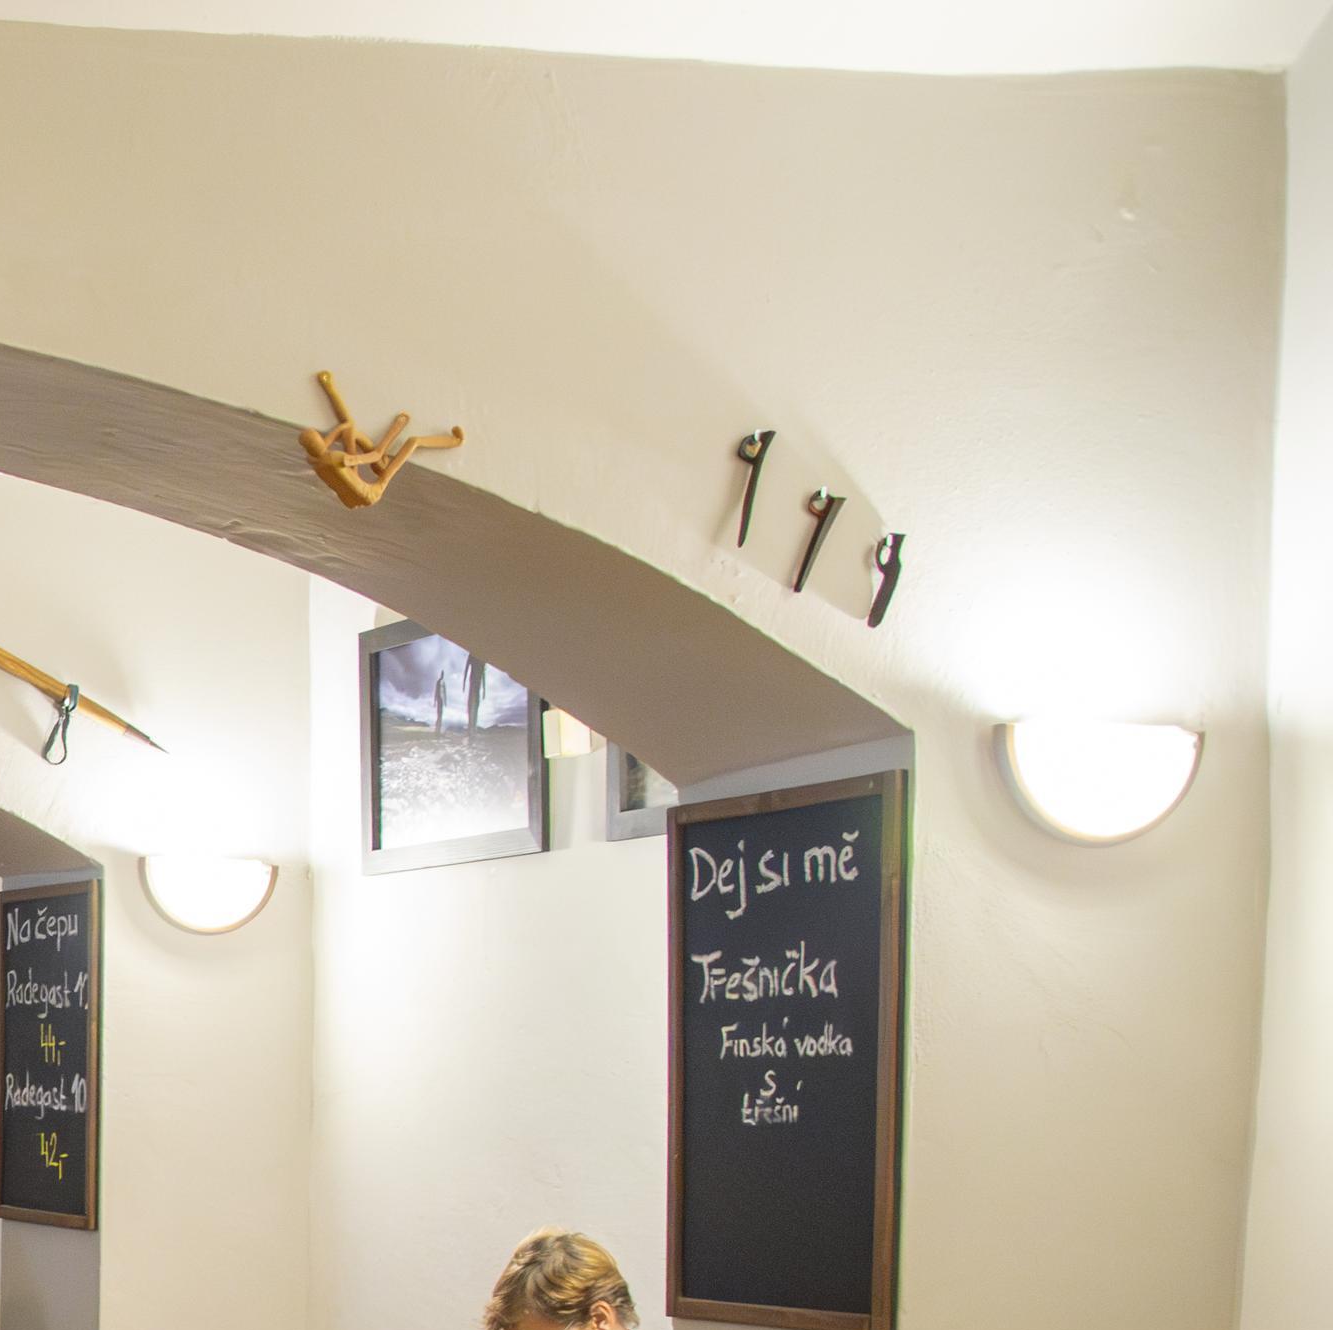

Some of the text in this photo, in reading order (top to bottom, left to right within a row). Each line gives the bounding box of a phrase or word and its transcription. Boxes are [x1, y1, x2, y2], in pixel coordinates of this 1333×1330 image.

[689, 829, 859, 920] Dej si mě
[6, 906, 79, 952] Na čepu
[6, 966, 71, 1019] Radegast
[691, 940, 839, 1003] Třešnička
[720, 1016, 854, 1060] Finská vodka
[5, 1069, 87, 1119] Radegast 10
